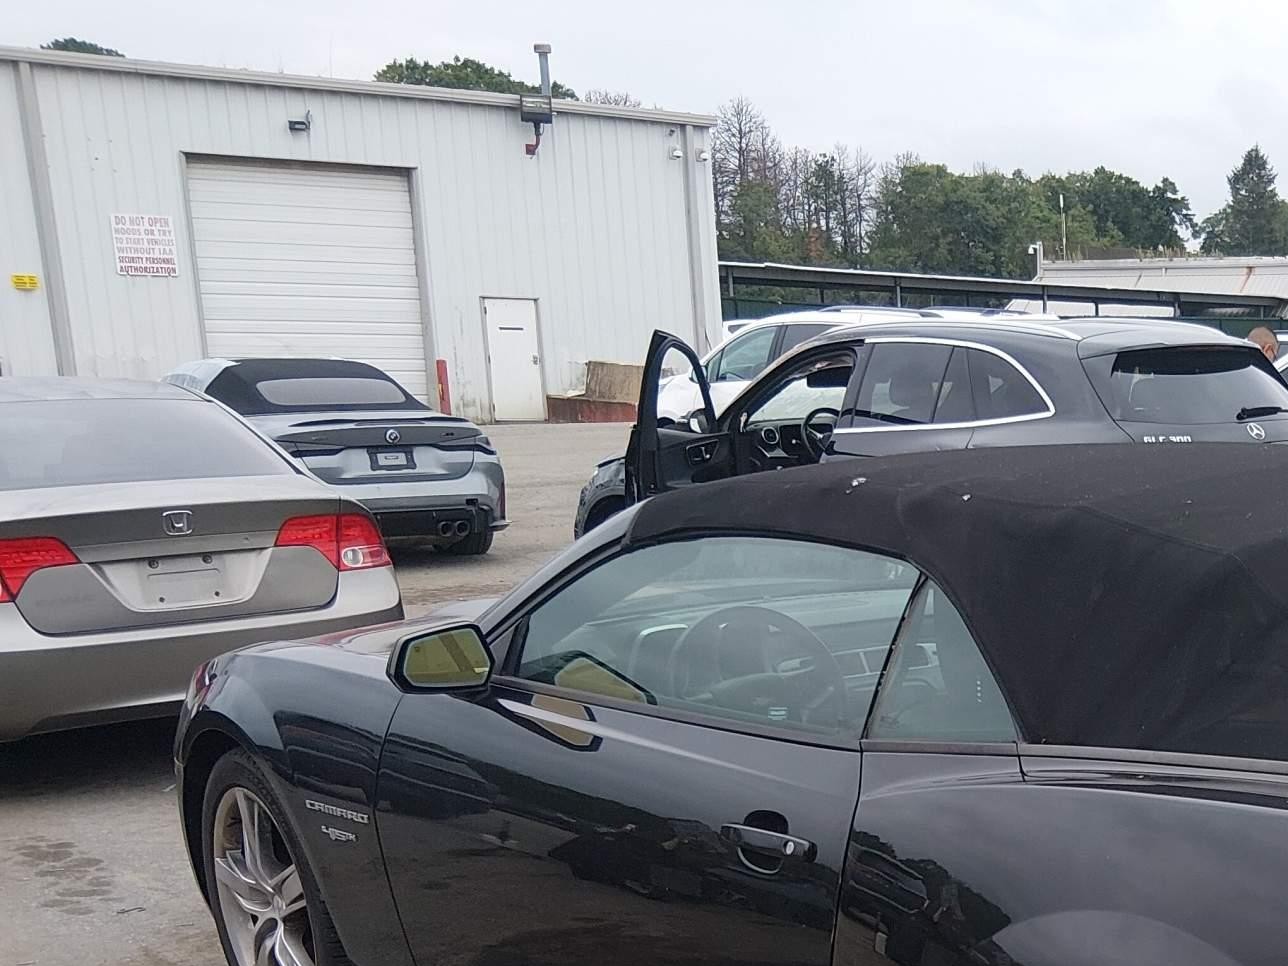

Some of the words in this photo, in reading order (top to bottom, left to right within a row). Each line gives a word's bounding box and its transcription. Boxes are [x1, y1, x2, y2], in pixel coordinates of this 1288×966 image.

[114, 215, 127, 226] DO
[129, 216, 145, 227] NOT
[148, 217, 170, 228] OPEN
[114, 227, 142, 236] HOODS
[144, 228, 155, 236] OR
[158, 229, 172, 237] TRY
[115, 236, 124, 245] TO
[125, 237, 145, 246] START
[146, 238, 175, 247] VEHICLES
[116, 246, 156, 255] WITHOUT
[158, 247, 174, 256] IAA
[118, 255, 144, 264] SECURITY
[145, 256, 176, 266] PERSONNEL
[119, 265, 177, 275] AUTHORIZATION
[305, 799, 369, 824] CAMARO
